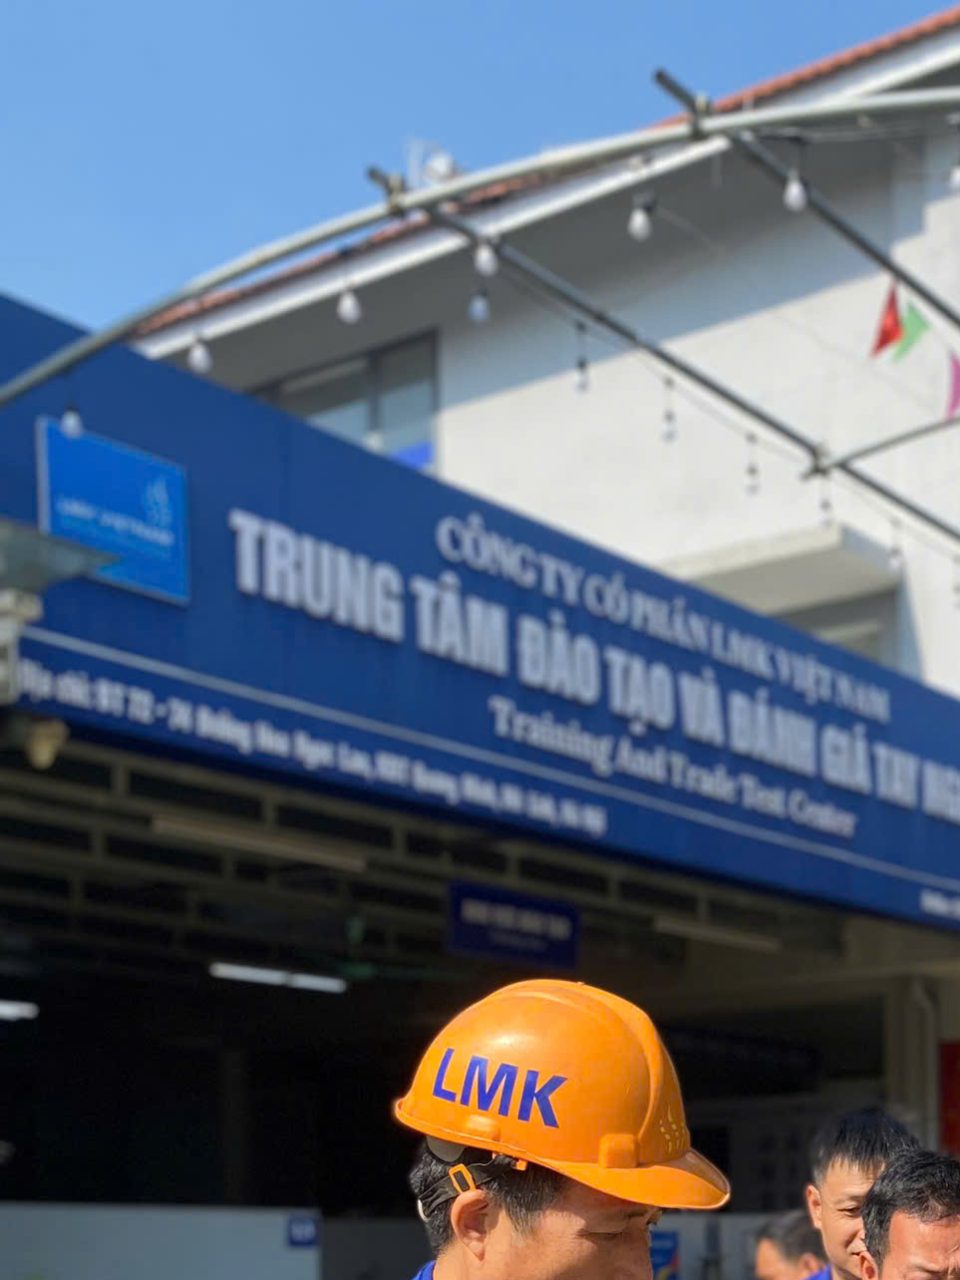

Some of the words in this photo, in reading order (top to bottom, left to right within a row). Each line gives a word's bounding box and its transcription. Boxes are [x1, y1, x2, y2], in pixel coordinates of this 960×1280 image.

[435, 511, 538, 589] CÔNG
[538, 553, 585, 605] TY
[228, 507, 405, 643] TRUNG
[410, 571, 508, 678] TÂM
[518, 609, 600, 705] ĐÀO
[605, 645, 676, 736] TẠO
[680, 667, 725, 748] VÀ
[488, 693, 615, 777] Training
[613, 736, 668, 787] And
[433, 1048, 568, 1128] LMK
